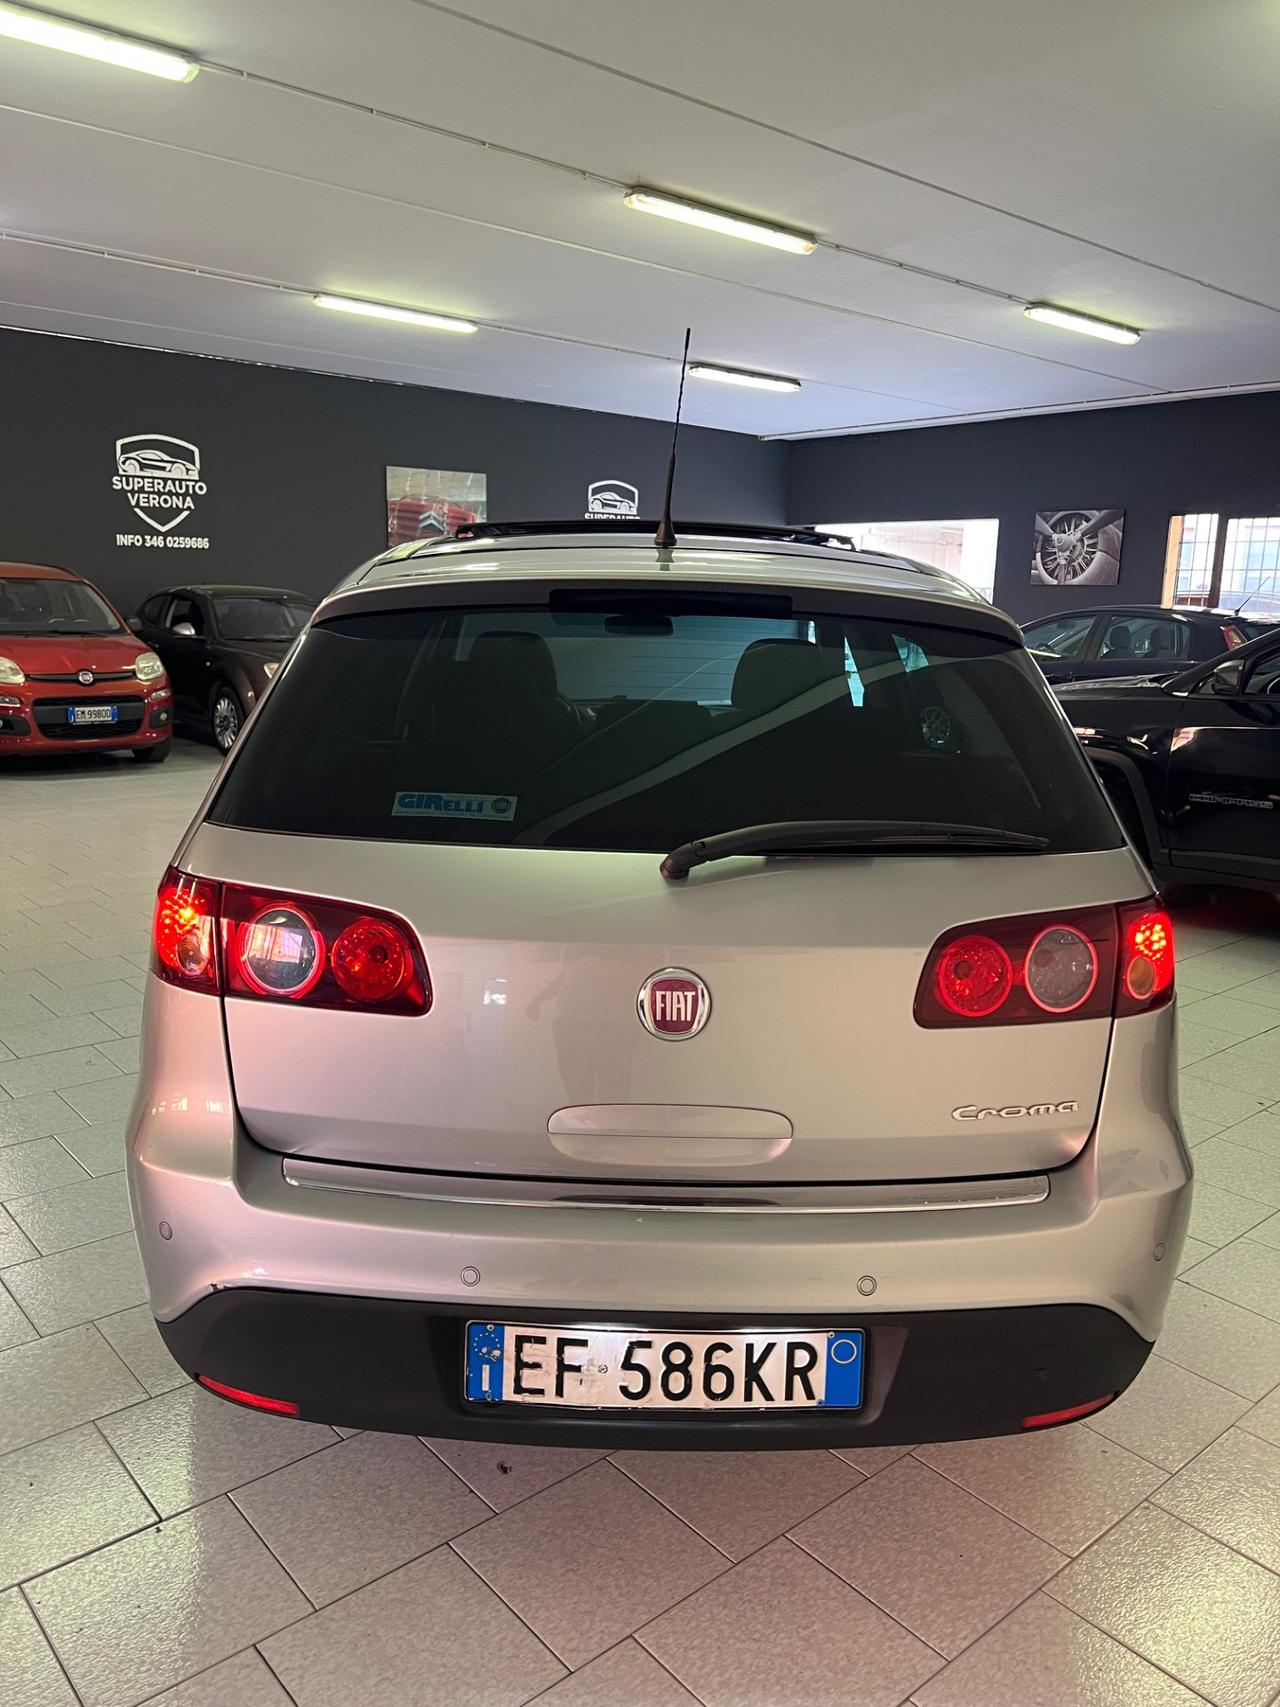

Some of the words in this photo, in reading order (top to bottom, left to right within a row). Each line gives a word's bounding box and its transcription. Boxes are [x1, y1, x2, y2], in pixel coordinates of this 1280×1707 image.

[112, 476, 207, 494] SUPERAUTO
[127, 492, 195, 510] VERONA
[116, 534, 142, 547] INFO
[144, 535, 164, 548] 346
[166, 536, 210, 549] 0259686
[655, 990, 696, 1022] FIAT
[952, 1100, 1079, 1121] Croma
[513, 1334, 589, 1399] EF
[618, 1339, 819, 1402] 586KR
